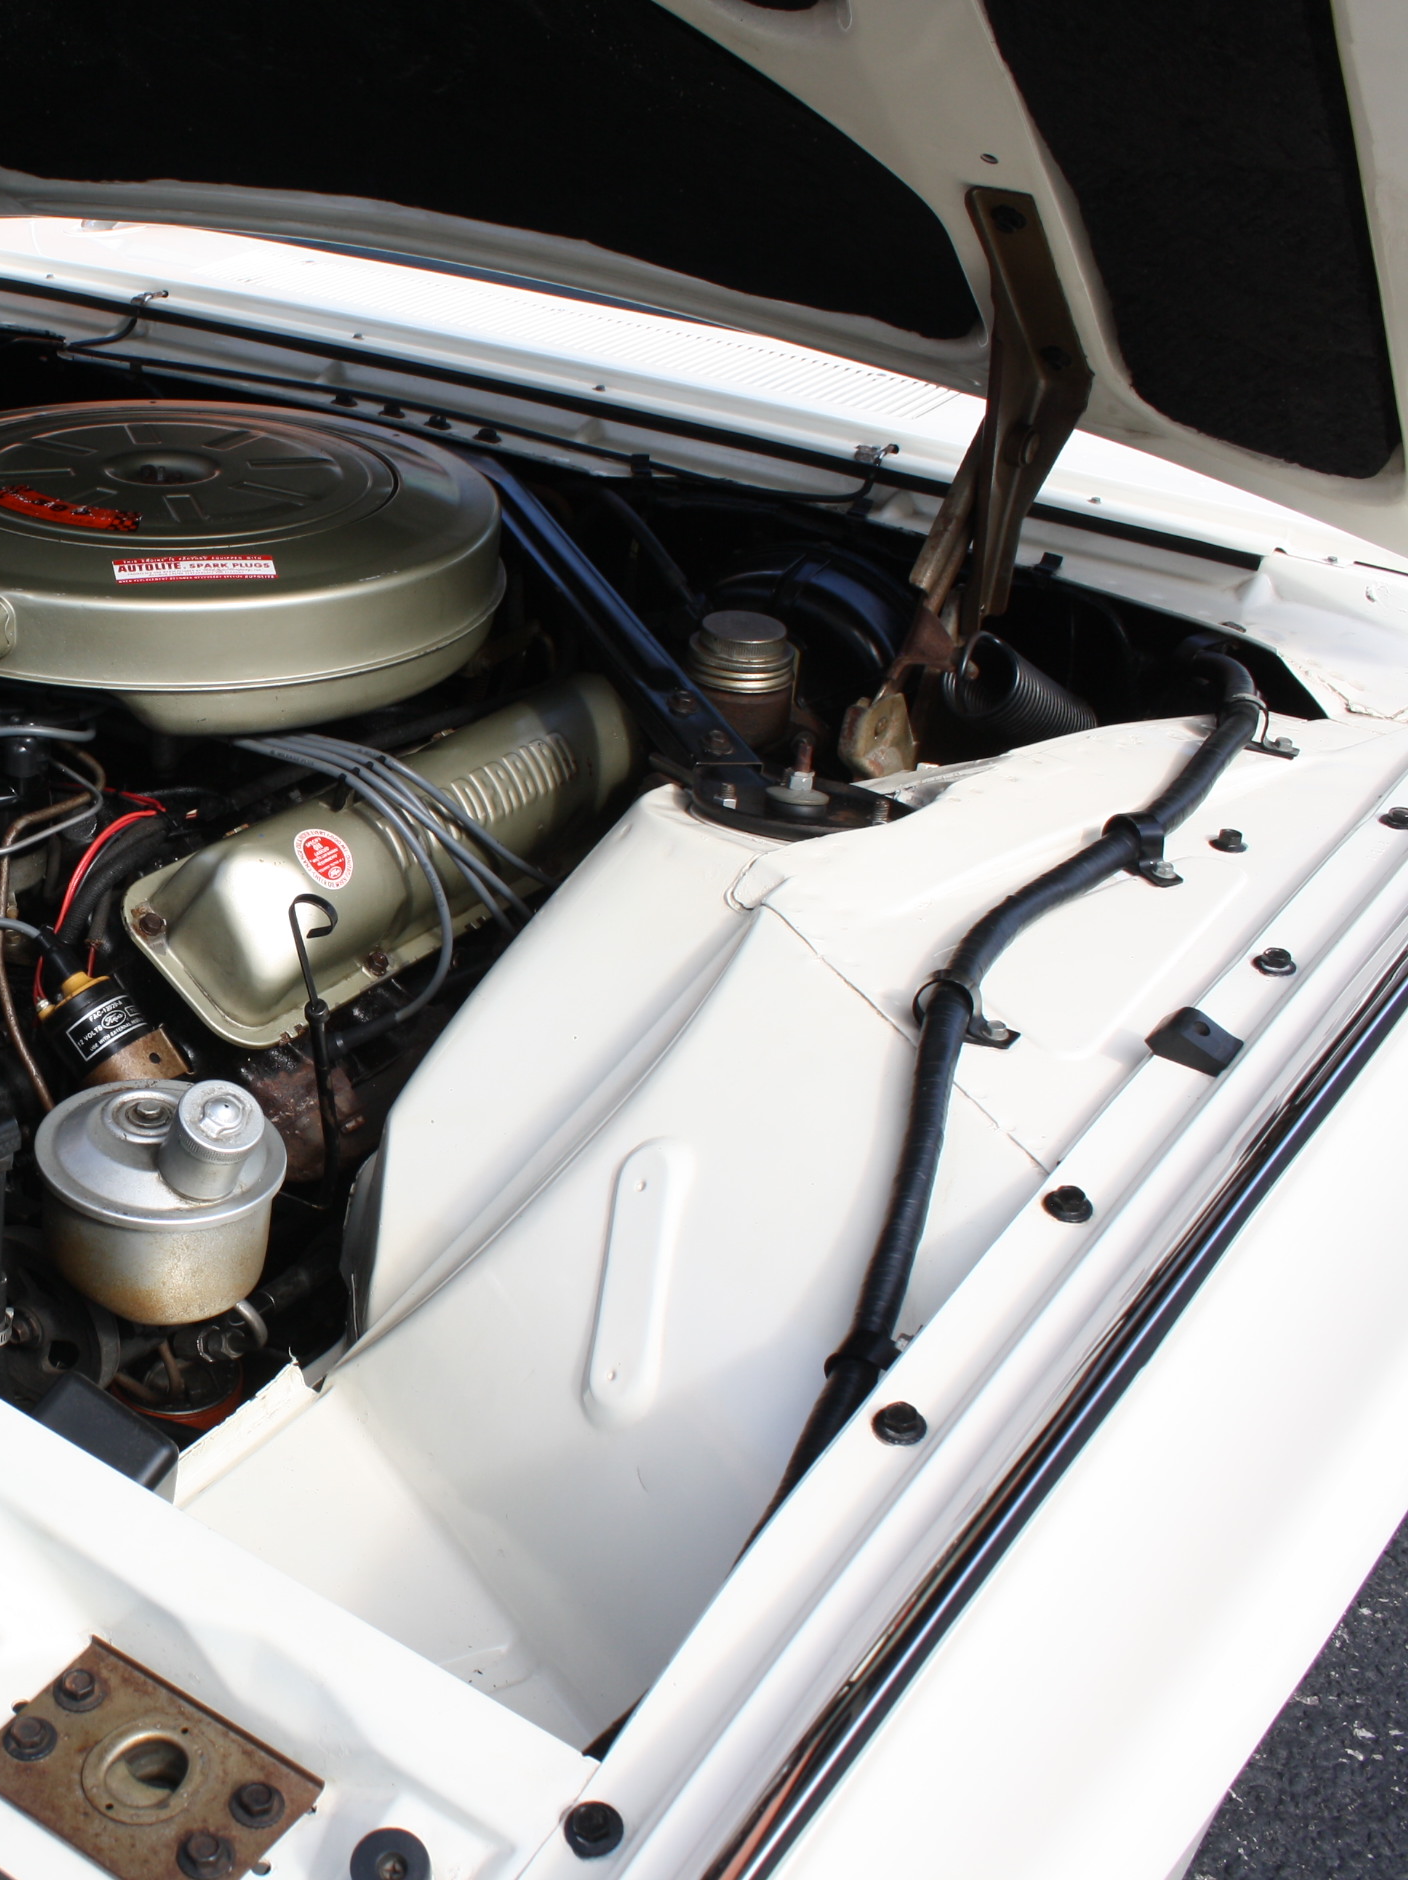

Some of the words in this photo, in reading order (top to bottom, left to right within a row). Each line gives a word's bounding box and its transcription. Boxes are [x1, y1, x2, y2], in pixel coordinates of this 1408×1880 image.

[117, 562, 181, 573] AUTOLITE
[232, 561, 271, 569] PLUGS
[84, 1025, 103, 1041] VOLTS
